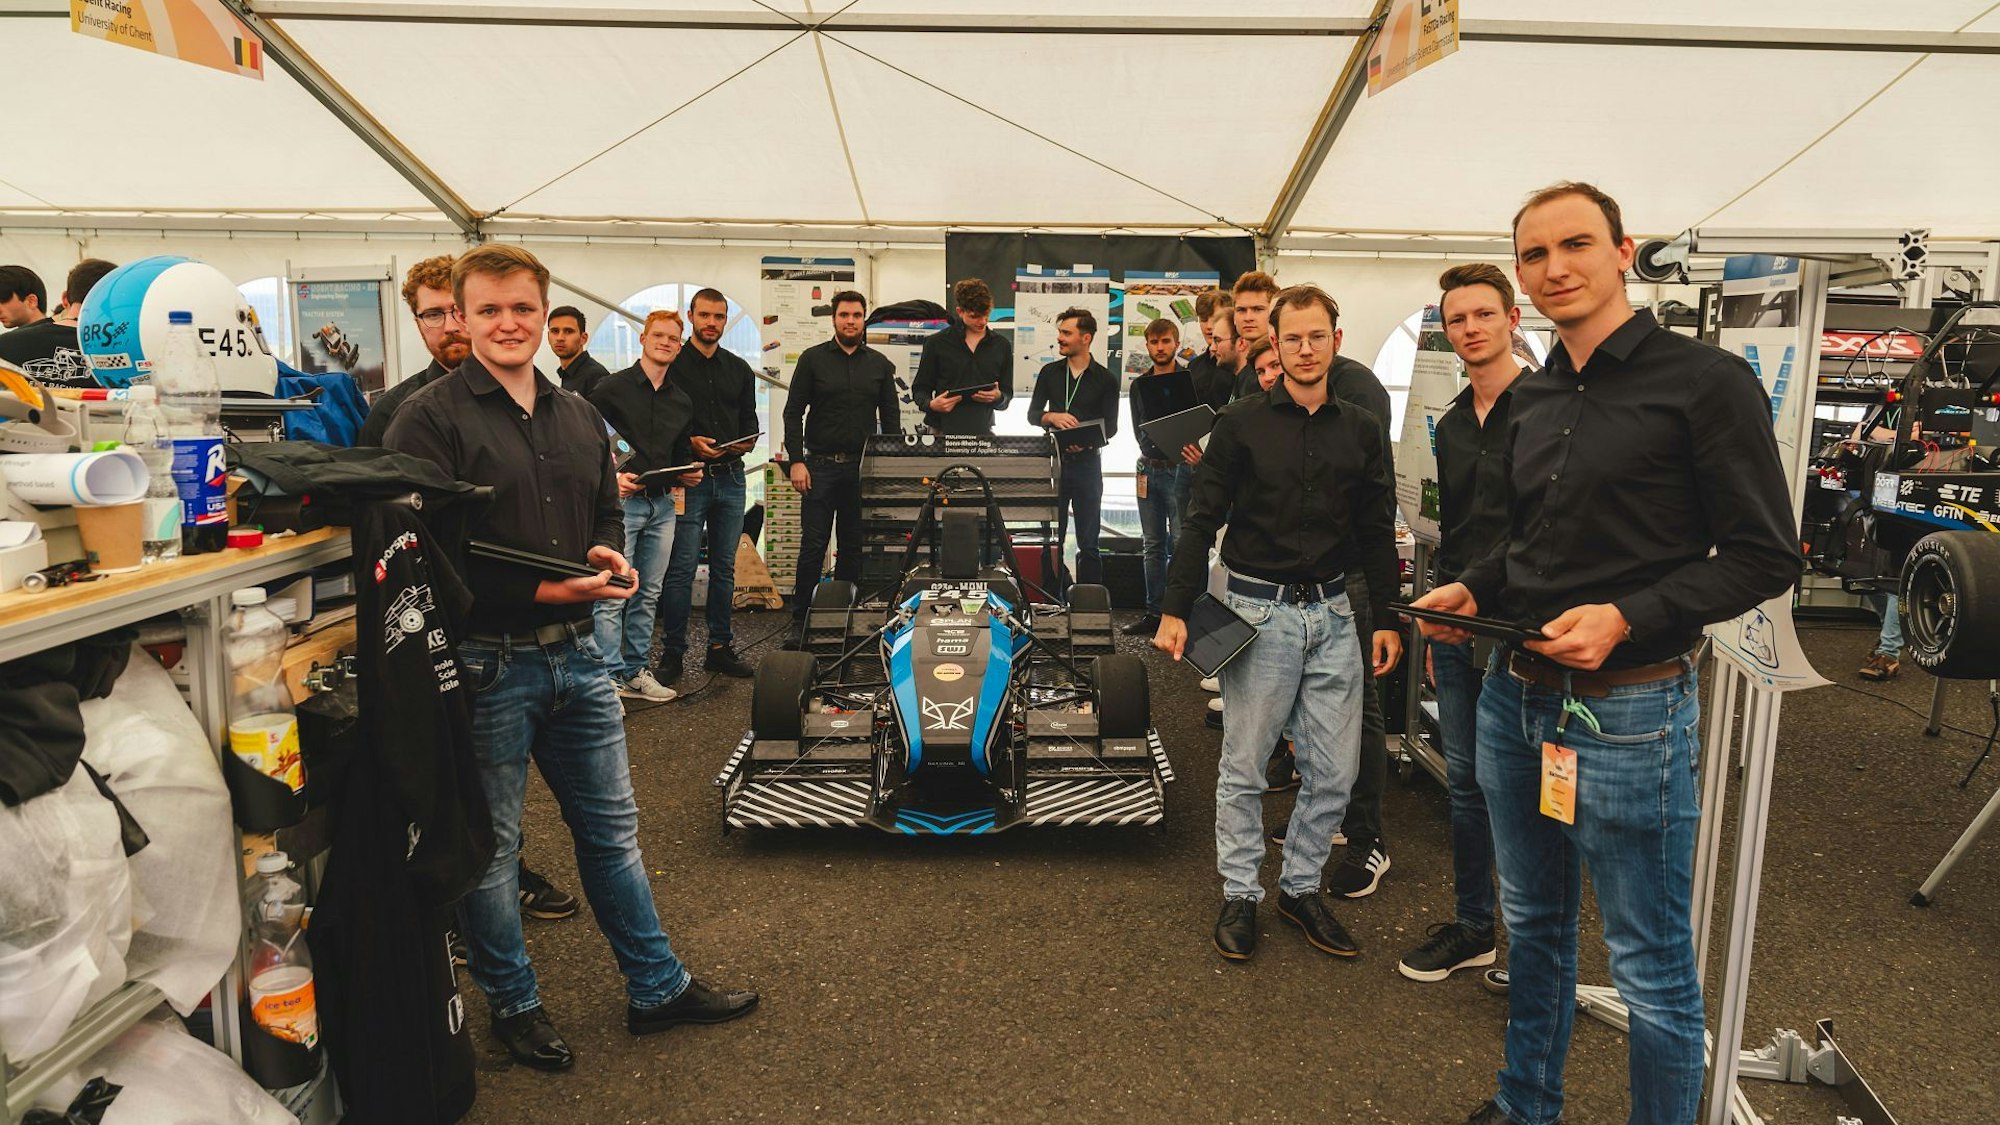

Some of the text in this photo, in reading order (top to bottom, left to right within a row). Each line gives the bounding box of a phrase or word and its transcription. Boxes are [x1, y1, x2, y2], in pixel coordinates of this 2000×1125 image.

[104, 2, 132, 18] Racing
[78, 10, 153, 42] University of Ghent
[1440, 10, 1455, 27] Racing
[84, 322, 114, 347] BRS
[977, 447, 997, 455] Applied
[1960, 486, 1983, 503] TE
[1933, 504, 1964, 520] GFTN
[1910, 541, 1950, 561] Hoosier
[439, 679, 460, 693] Köln
[265, 996, 302, 1010] ice tea
